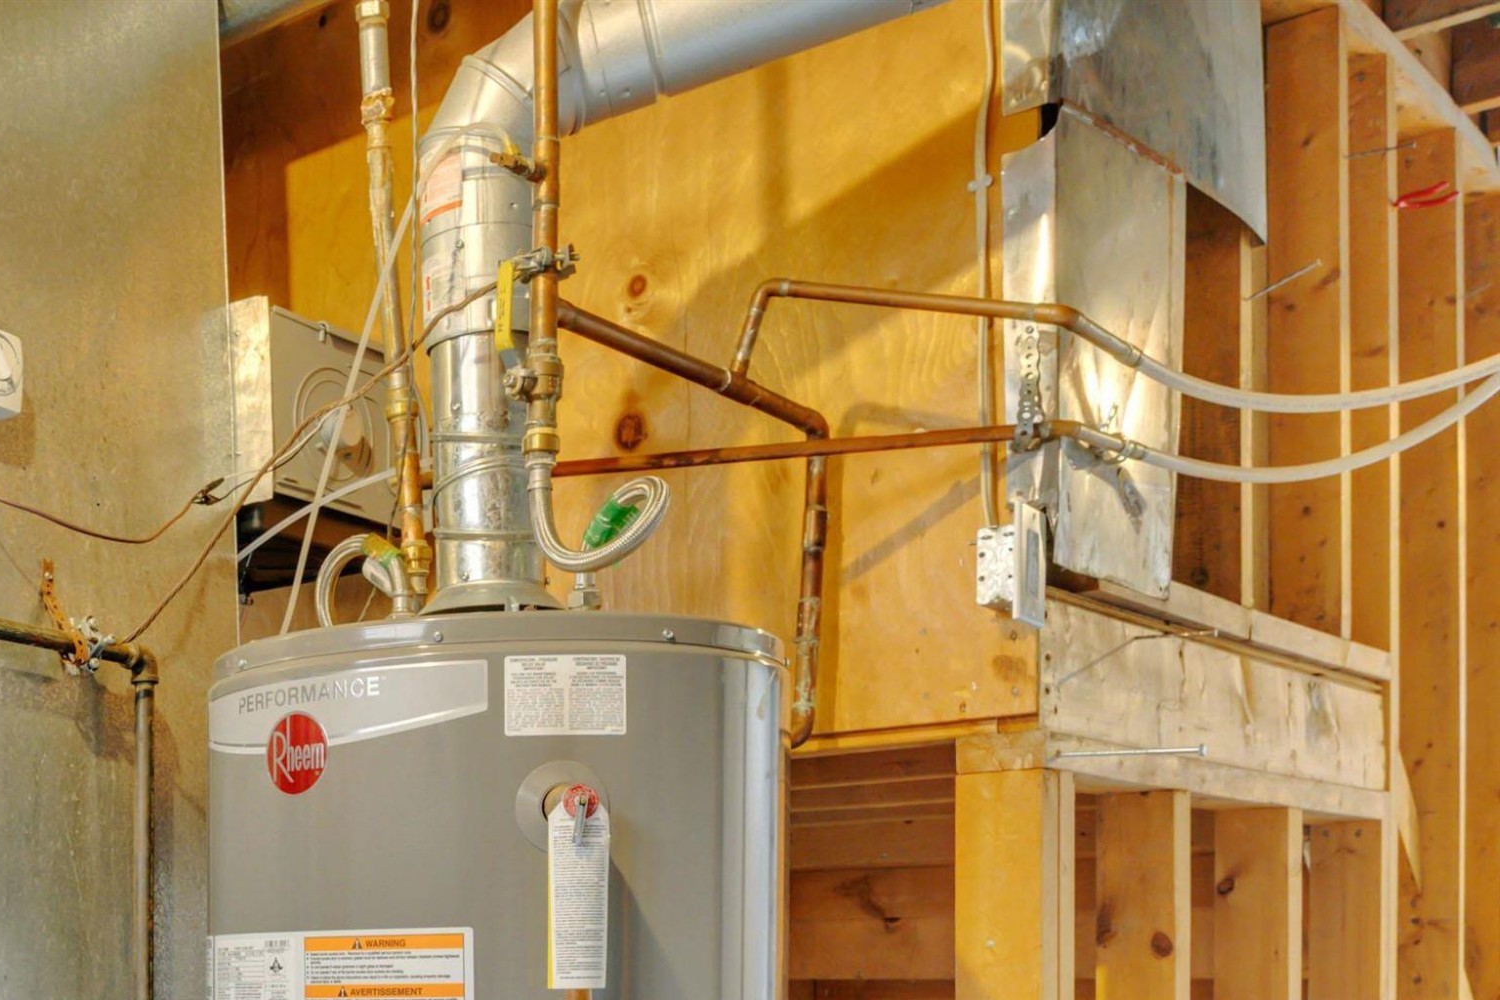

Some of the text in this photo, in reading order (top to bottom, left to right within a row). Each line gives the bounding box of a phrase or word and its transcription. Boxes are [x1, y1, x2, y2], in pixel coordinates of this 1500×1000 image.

[238, 676, 380, 715] PERFORMANCE
[273, 716, 325, 783] Rheem
[366, 939, 406, 948] WARNING
[350, 987, 422, 996] AVERTISSEMENT
